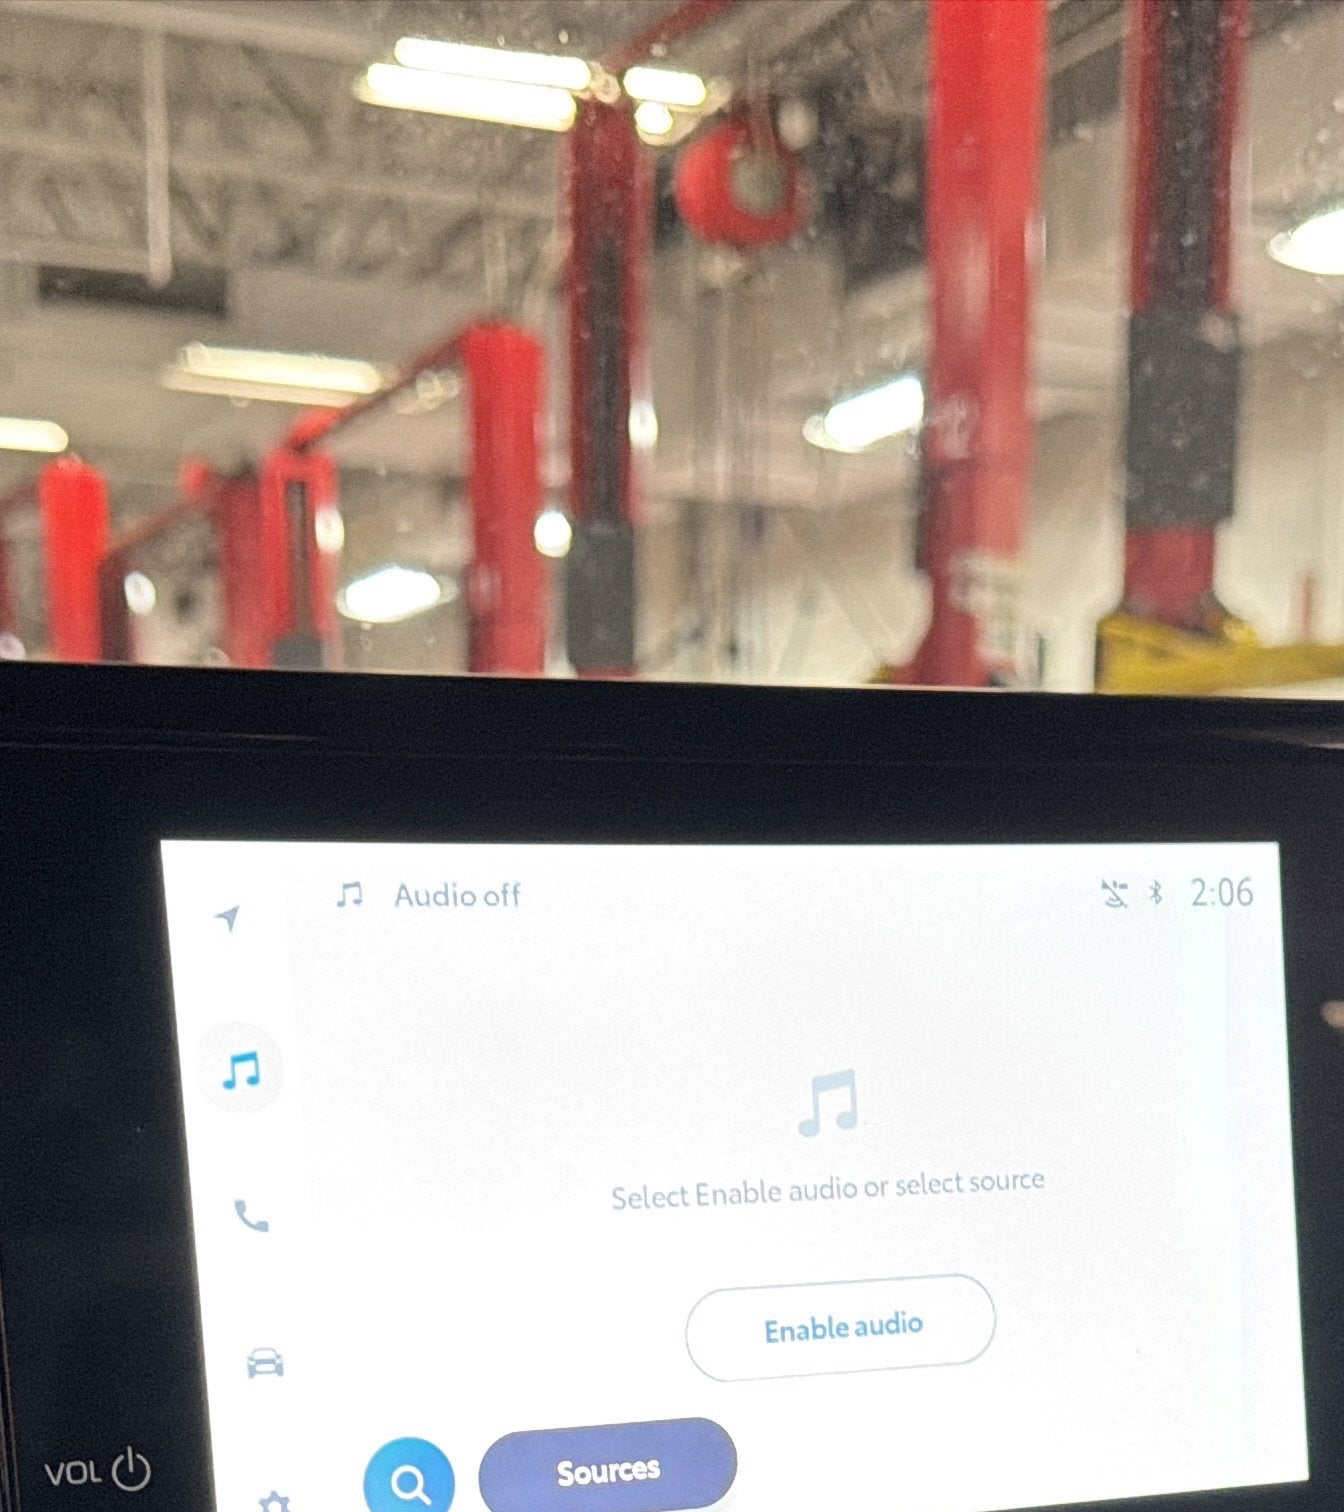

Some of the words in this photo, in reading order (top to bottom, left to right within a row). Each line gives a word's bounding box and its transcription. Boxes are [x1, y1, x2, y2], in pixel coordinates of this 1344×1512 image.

[394, 881, 476, 908] Audio
[483, 881, 521, 907] off
[1191, 876, 1254, 907] 2:06
[612, 1185, 690, 1210] Select
[696, 1180, 782, 1207] Enable
[789, 1176, 858, 1200] audio
[863, 1180, 892, 1198] or
[895, 1172, 964, 1197] select
[969, 1170, 1045, 1192] source
[765, 1314, 849, 1343] Enable
[855, 1310, 923, 1338] audio
[44, 1460, 102, 1487] VOL
[557, 1459, 661, 1487] Sources
